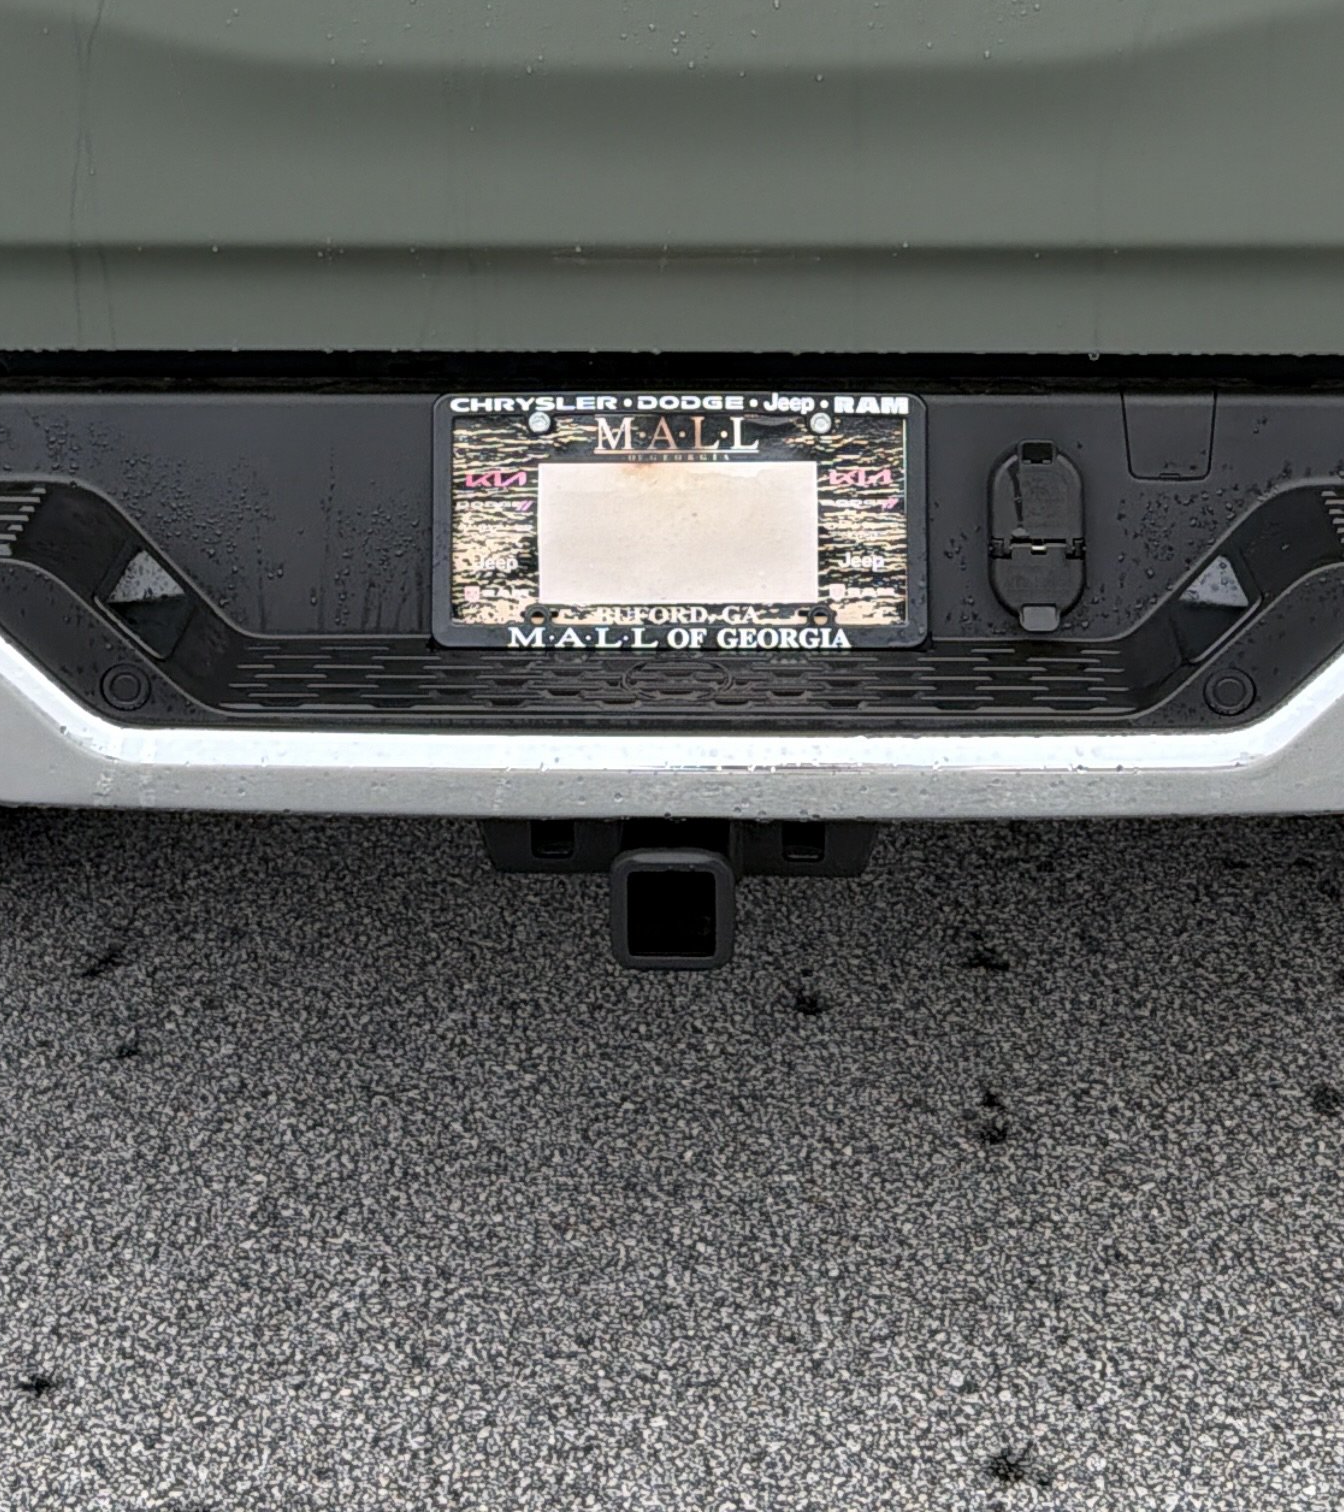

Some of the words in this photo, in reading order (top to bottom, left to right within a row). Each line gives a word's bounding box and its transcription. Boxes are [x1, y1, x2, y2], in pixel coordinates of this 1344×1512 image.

[450, 396, 617, 412] CHRYSLER
[637, 395, 744, 410] DODGE
[763, 392, 815, 415] Jeep
[834, 396, 909, 414] RAM
[839, 552, 884, 572] Jeep
[722, 605, 757, 623] GA
[667, 628, 707, 649] OF
[716, 628, 852, 649] GEORGIA
